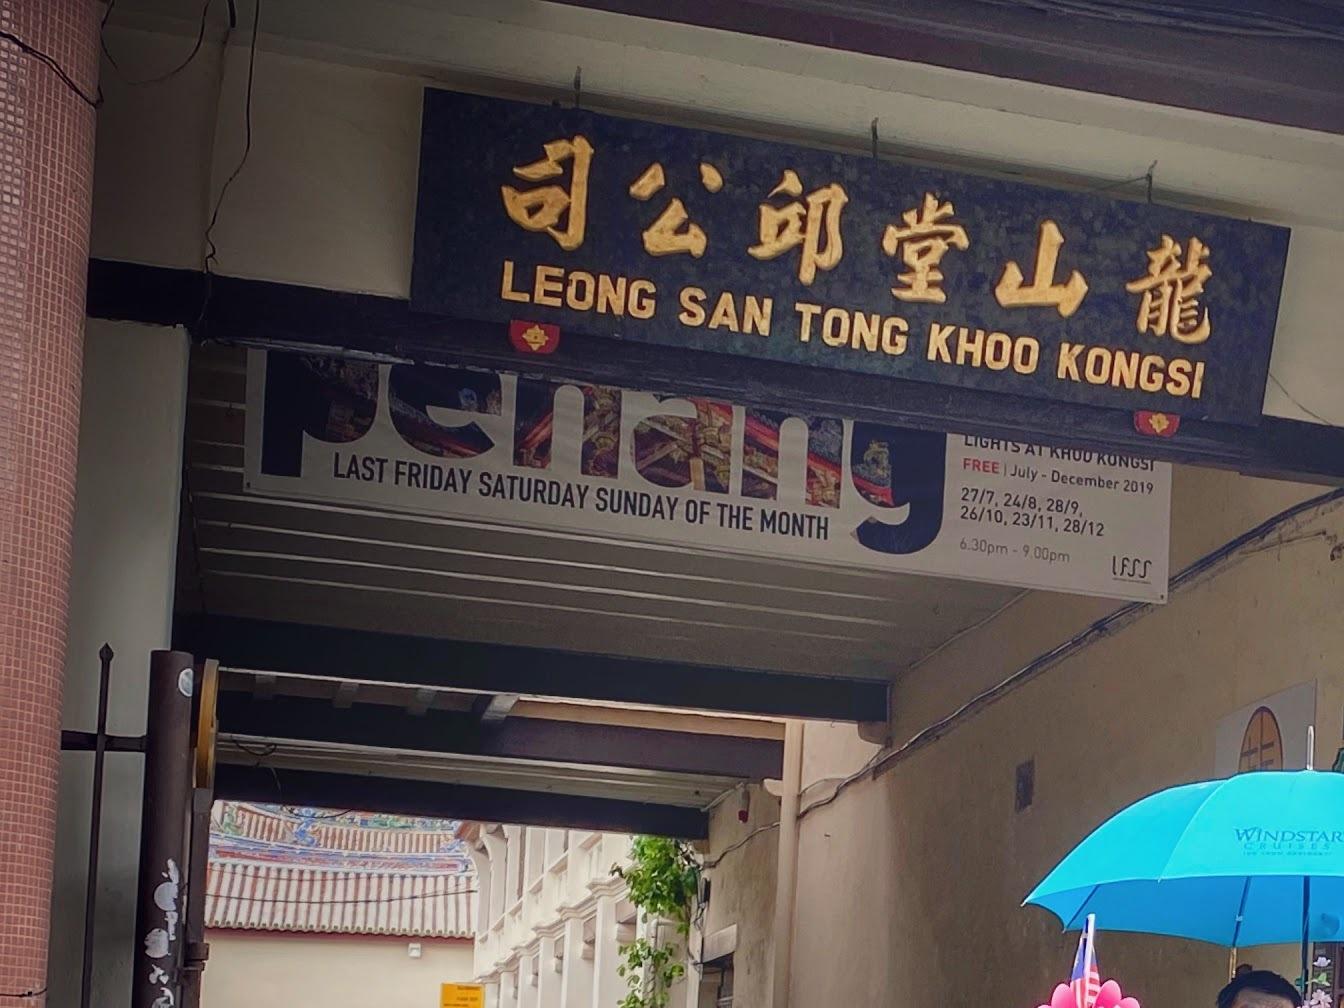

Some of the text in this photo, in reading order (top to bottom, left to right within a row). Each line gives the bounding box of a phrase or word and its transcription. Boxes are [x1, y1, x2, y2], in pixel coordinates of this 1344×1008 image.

[500, 260, 1206, 398] LEONG SAN TONG KHOO KONGSI
[963, 458, 999, 474] FREE
[1010, 464, 1038, 482] July
[1051, 470, 1120, 490] December
[1123, 480, 1154, 495] 2019
[333, 452, 829, 541] LAST FRIDAY SATURDAY SUNDAY OF THE MONTH
[961, 487, 1083, 518] 27/7, 24/8, 28/9,
[960, 506, 1105, 537] 26/10, 23/11, 28/12
[960, 537, 1008, 556] 6.30pm
[1234, 826, 1344, 843] WINDSTAR
